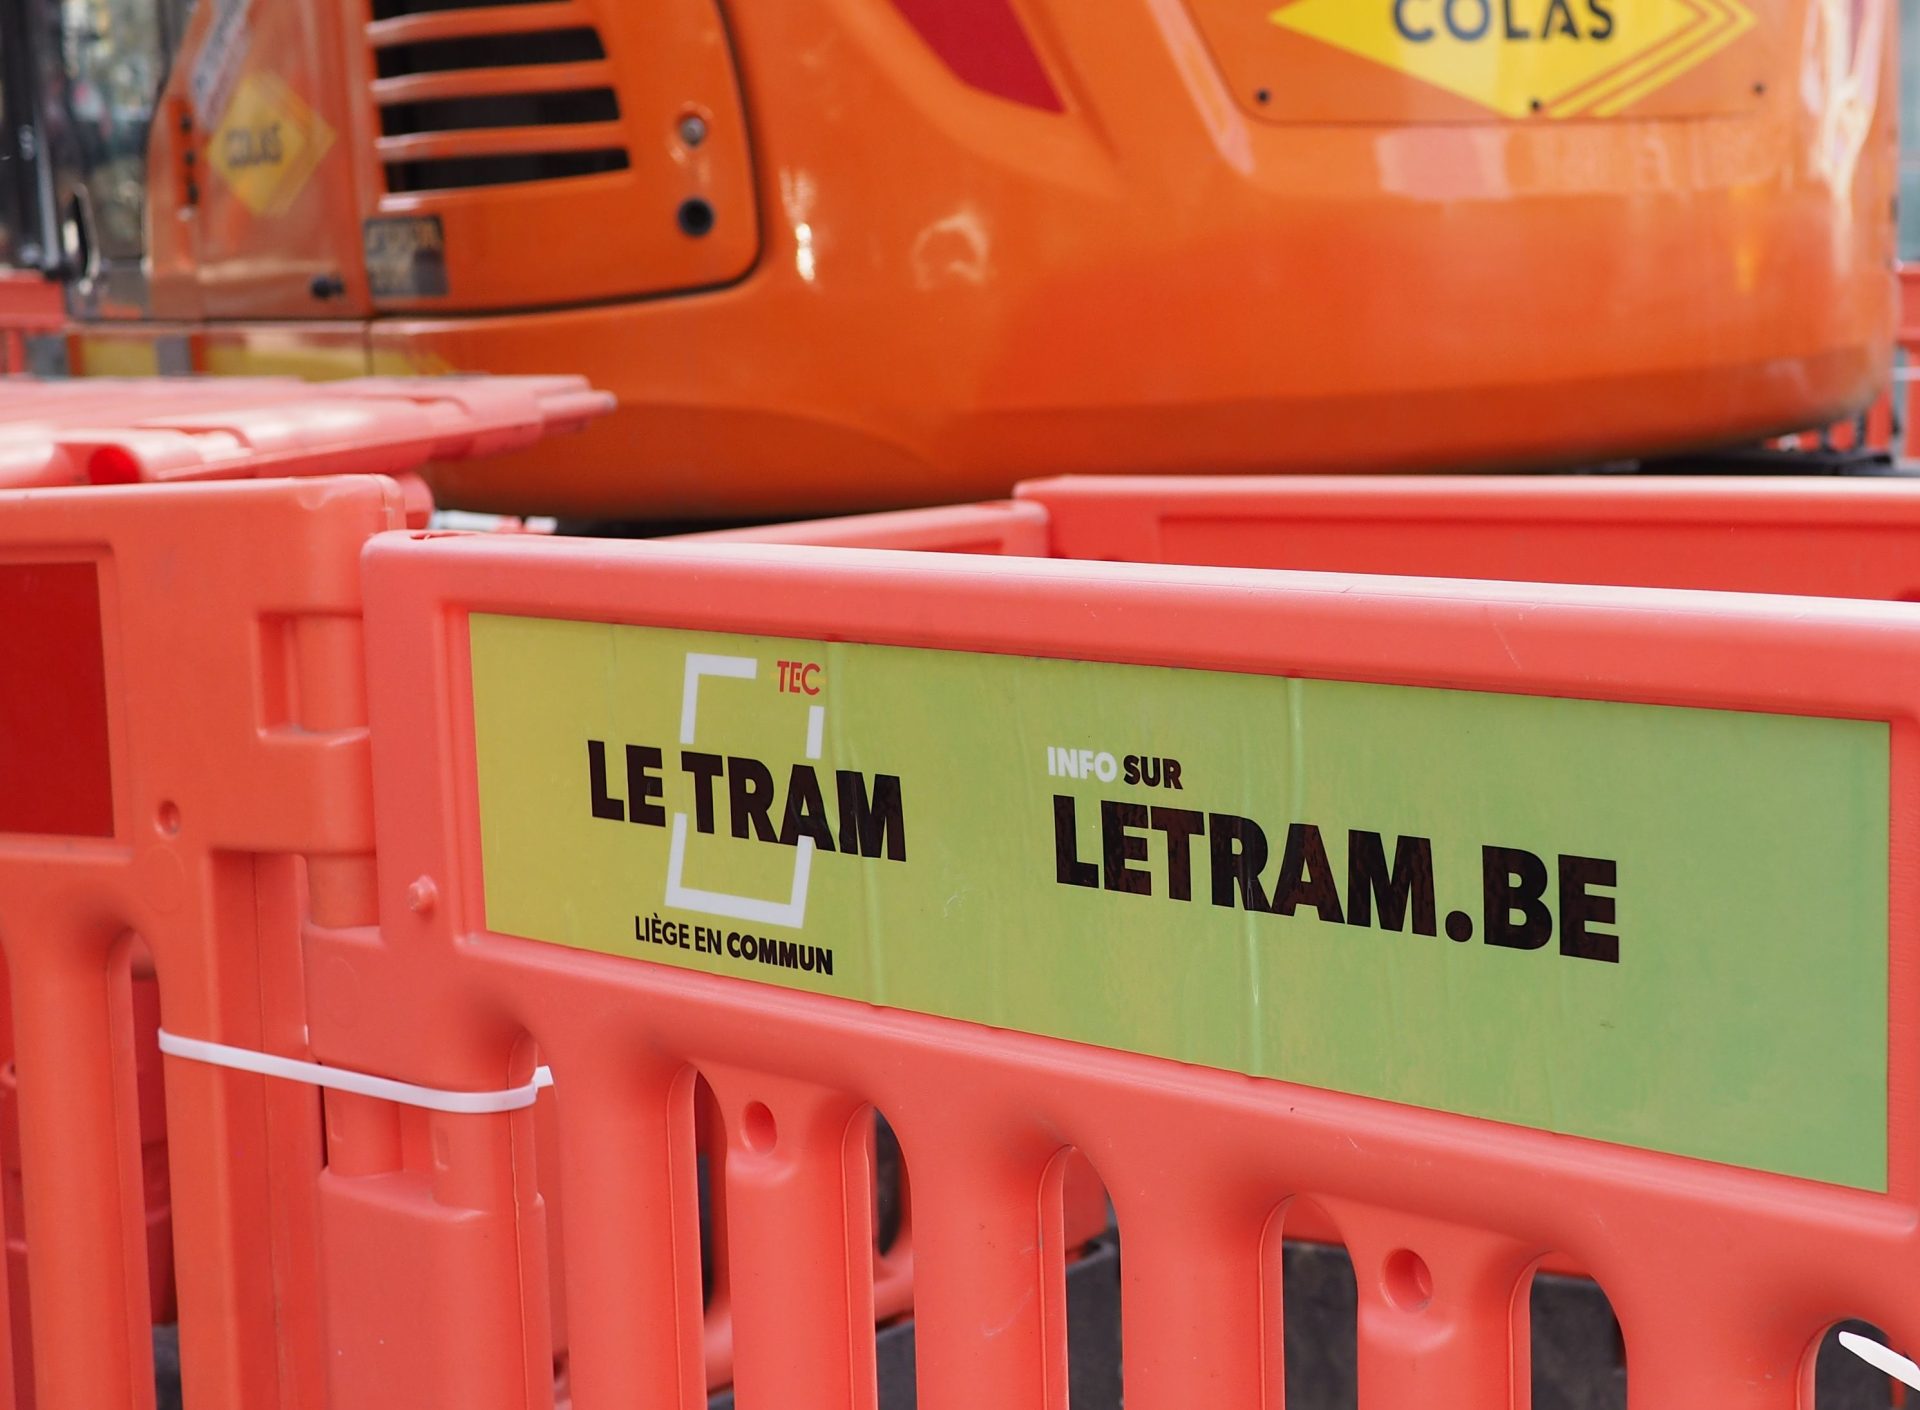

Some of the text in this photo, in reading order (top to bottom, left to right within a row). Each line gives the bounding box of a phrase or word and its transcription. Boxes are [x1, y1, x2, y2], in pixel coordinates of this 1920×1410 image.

[1393, 0, 1614, 42] COLAS
[777, 660, 821, 696] TEC
[1047, 746, 1184, 790] INFO SUR
[587, 739, 907, 863] LE TRAM
[1053, 794, 1620, 964] LETRAM.BE
[635, 912, 833, 976] LIÈGE EN COMMUN
